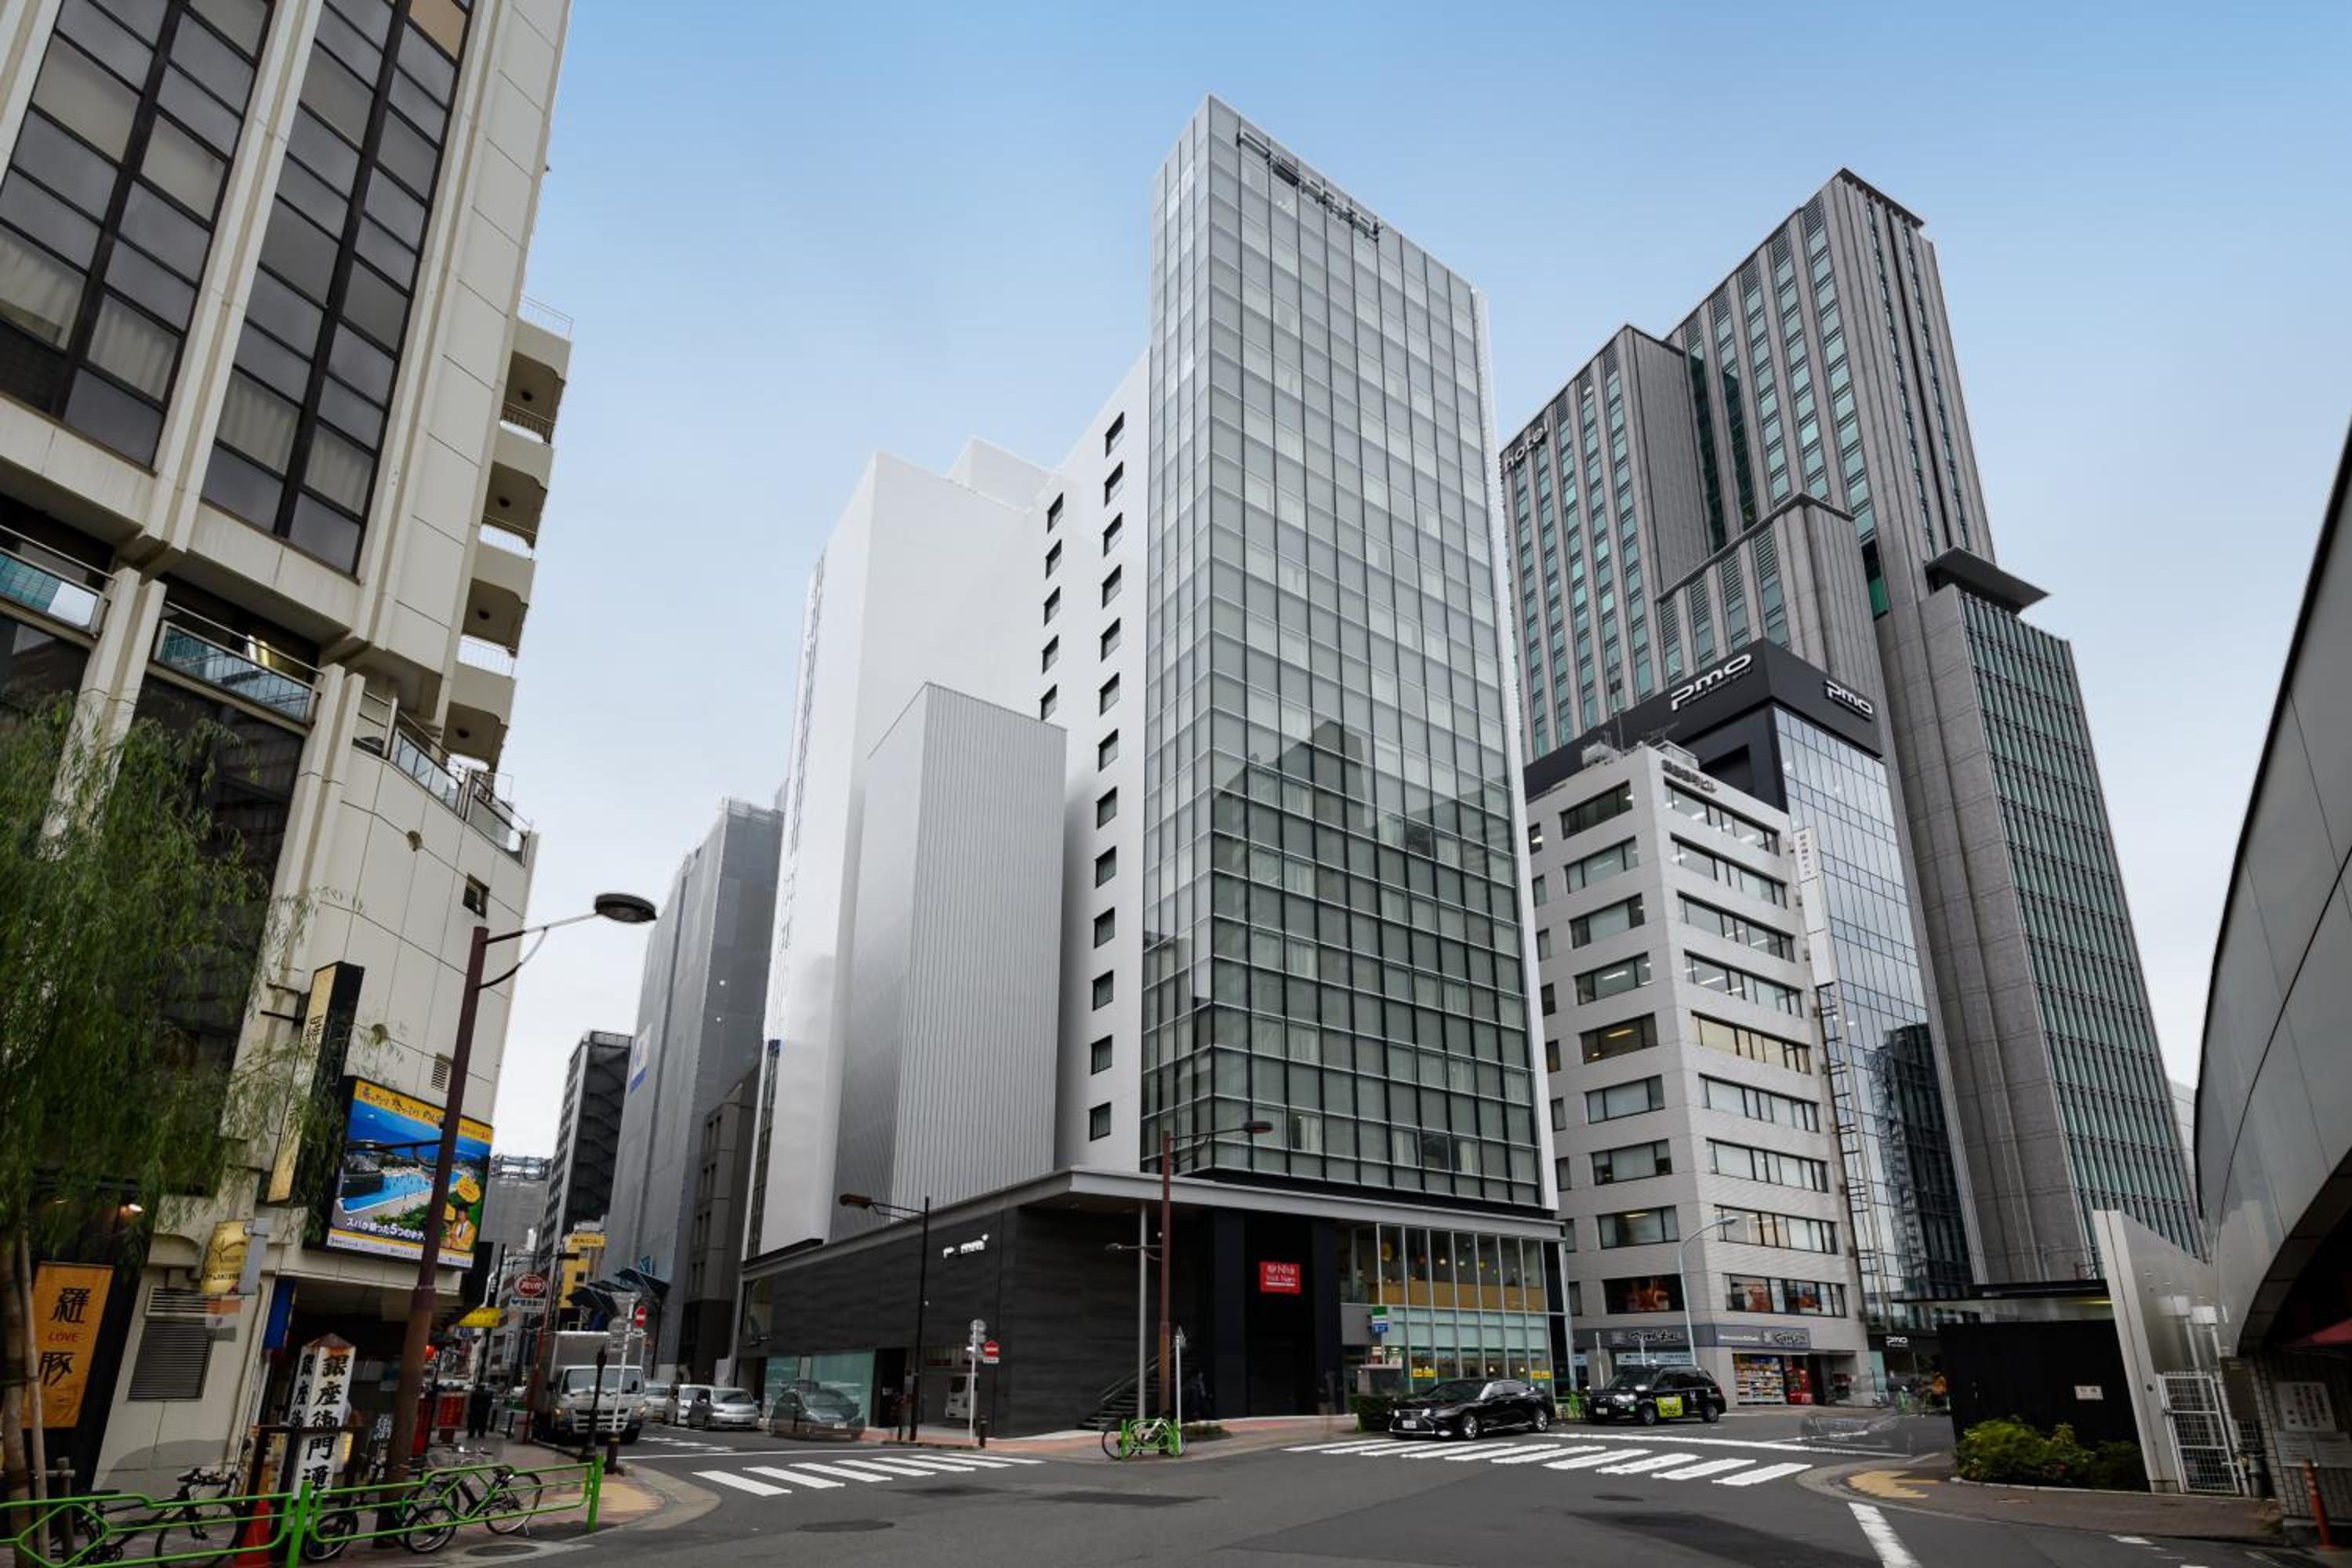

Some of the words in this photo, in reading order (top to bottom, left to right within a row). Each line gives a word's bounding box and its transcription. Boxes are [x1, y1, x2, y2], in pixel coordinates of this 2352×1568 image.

[1504, 418, 1549, 472] hotel
[49, 1287, 91, 1324] 羅
[48, 1331, 82, 1343] LOVE
